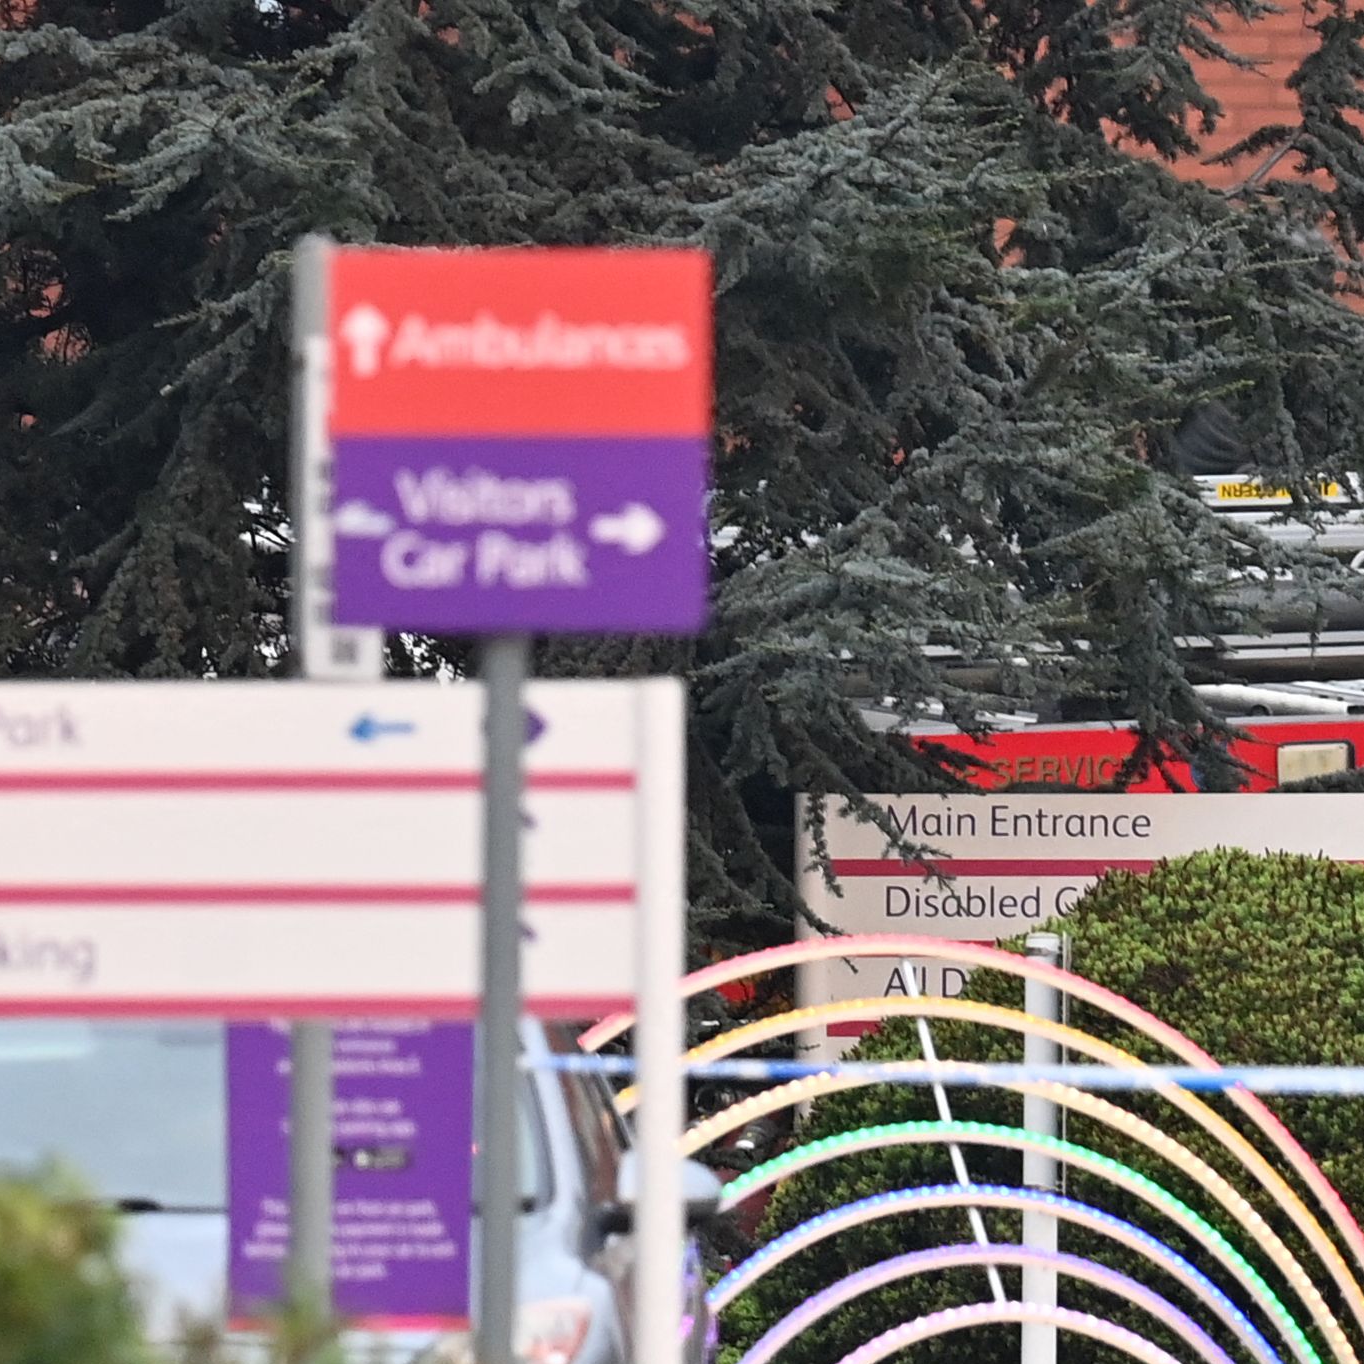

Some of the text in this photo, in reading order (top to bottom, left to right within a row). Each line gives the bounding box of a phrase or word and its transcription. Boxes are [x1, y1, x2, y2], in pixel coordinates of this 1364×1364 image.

[391, 311, 689, 368] Ambulances
[395, 468, 575, 523] Visitors
[381, 530, 588, 588] Car Park
[992, 756, 1144, 788] SERVIC
[887, 804, 1151, 838] Main Entrance
[885, 885, 1041, 919] Disabled
